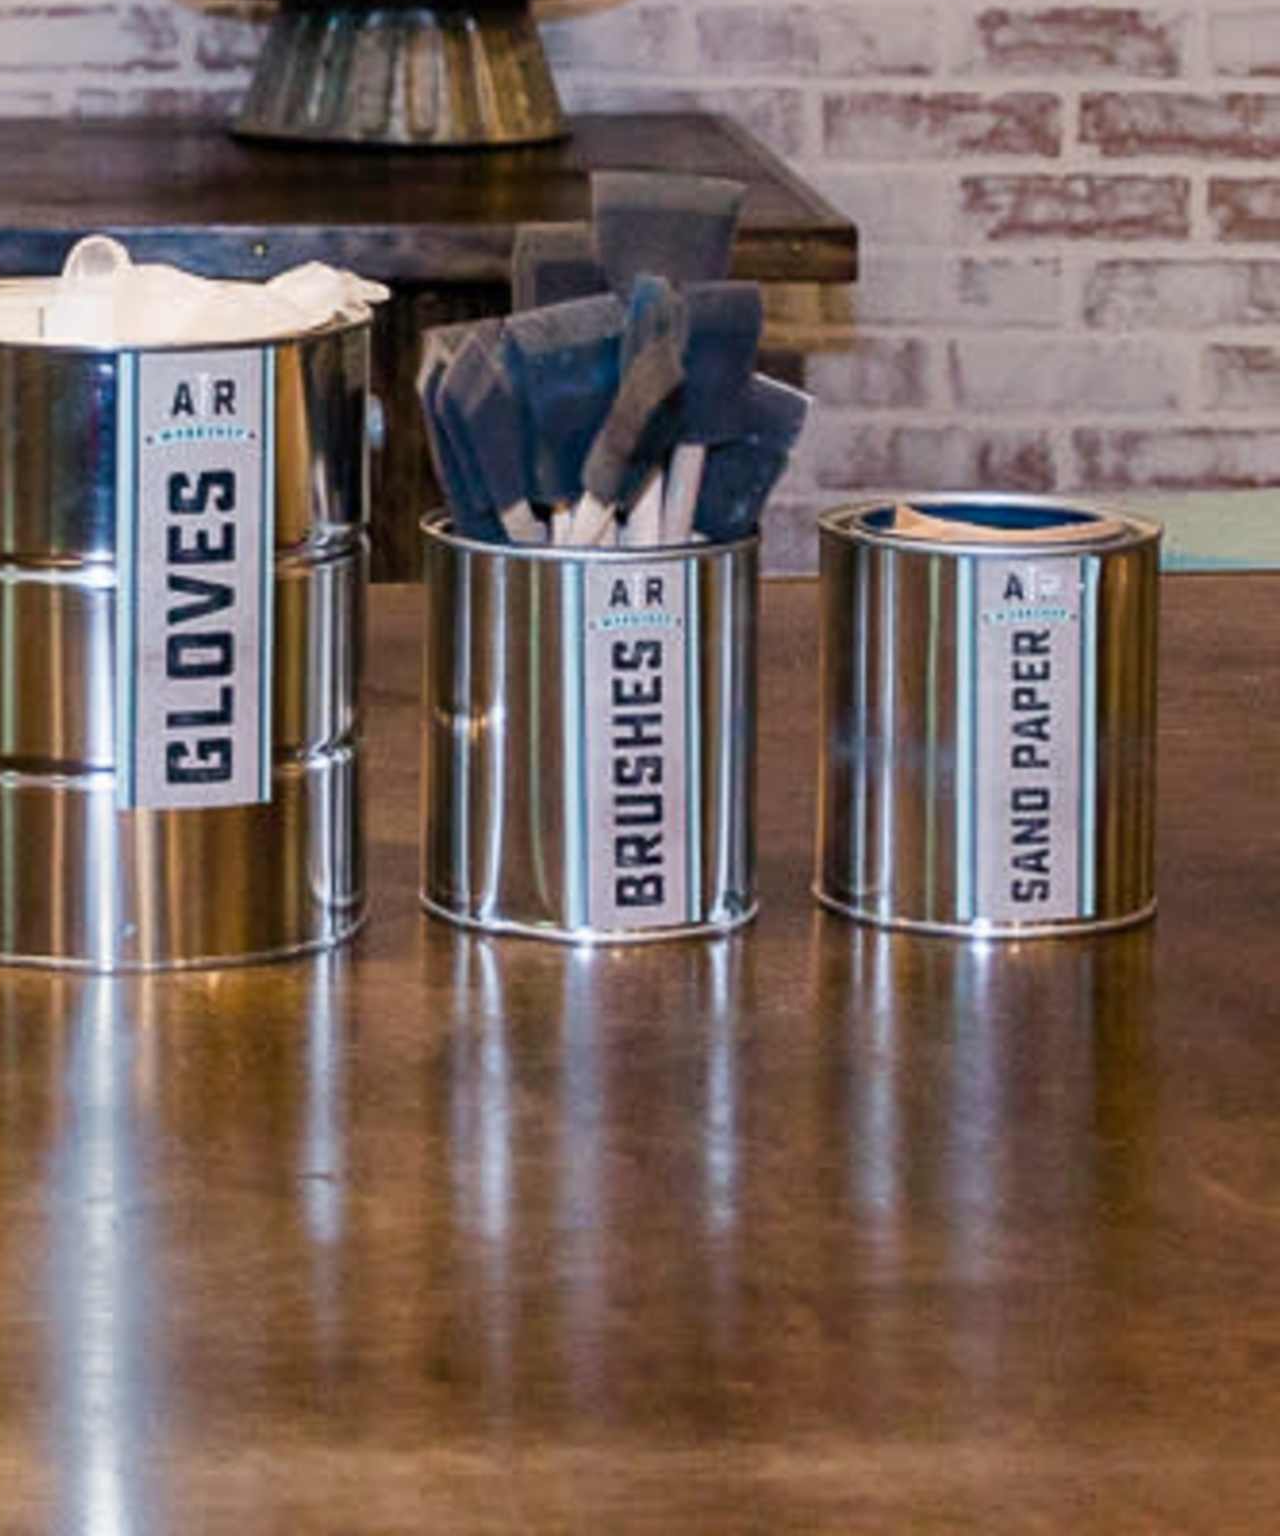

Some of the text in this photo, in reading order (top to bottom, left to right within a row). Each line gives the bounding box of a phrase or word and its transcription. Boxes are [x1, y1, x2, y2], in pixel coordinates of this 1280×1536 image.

[165, 469, 236, 785] GLOVES
[1010, 629, 1050, 769] PAPER
[611, 639, 665, 907] BRUSHES
[1010, 786, 1050, 904] SAND
